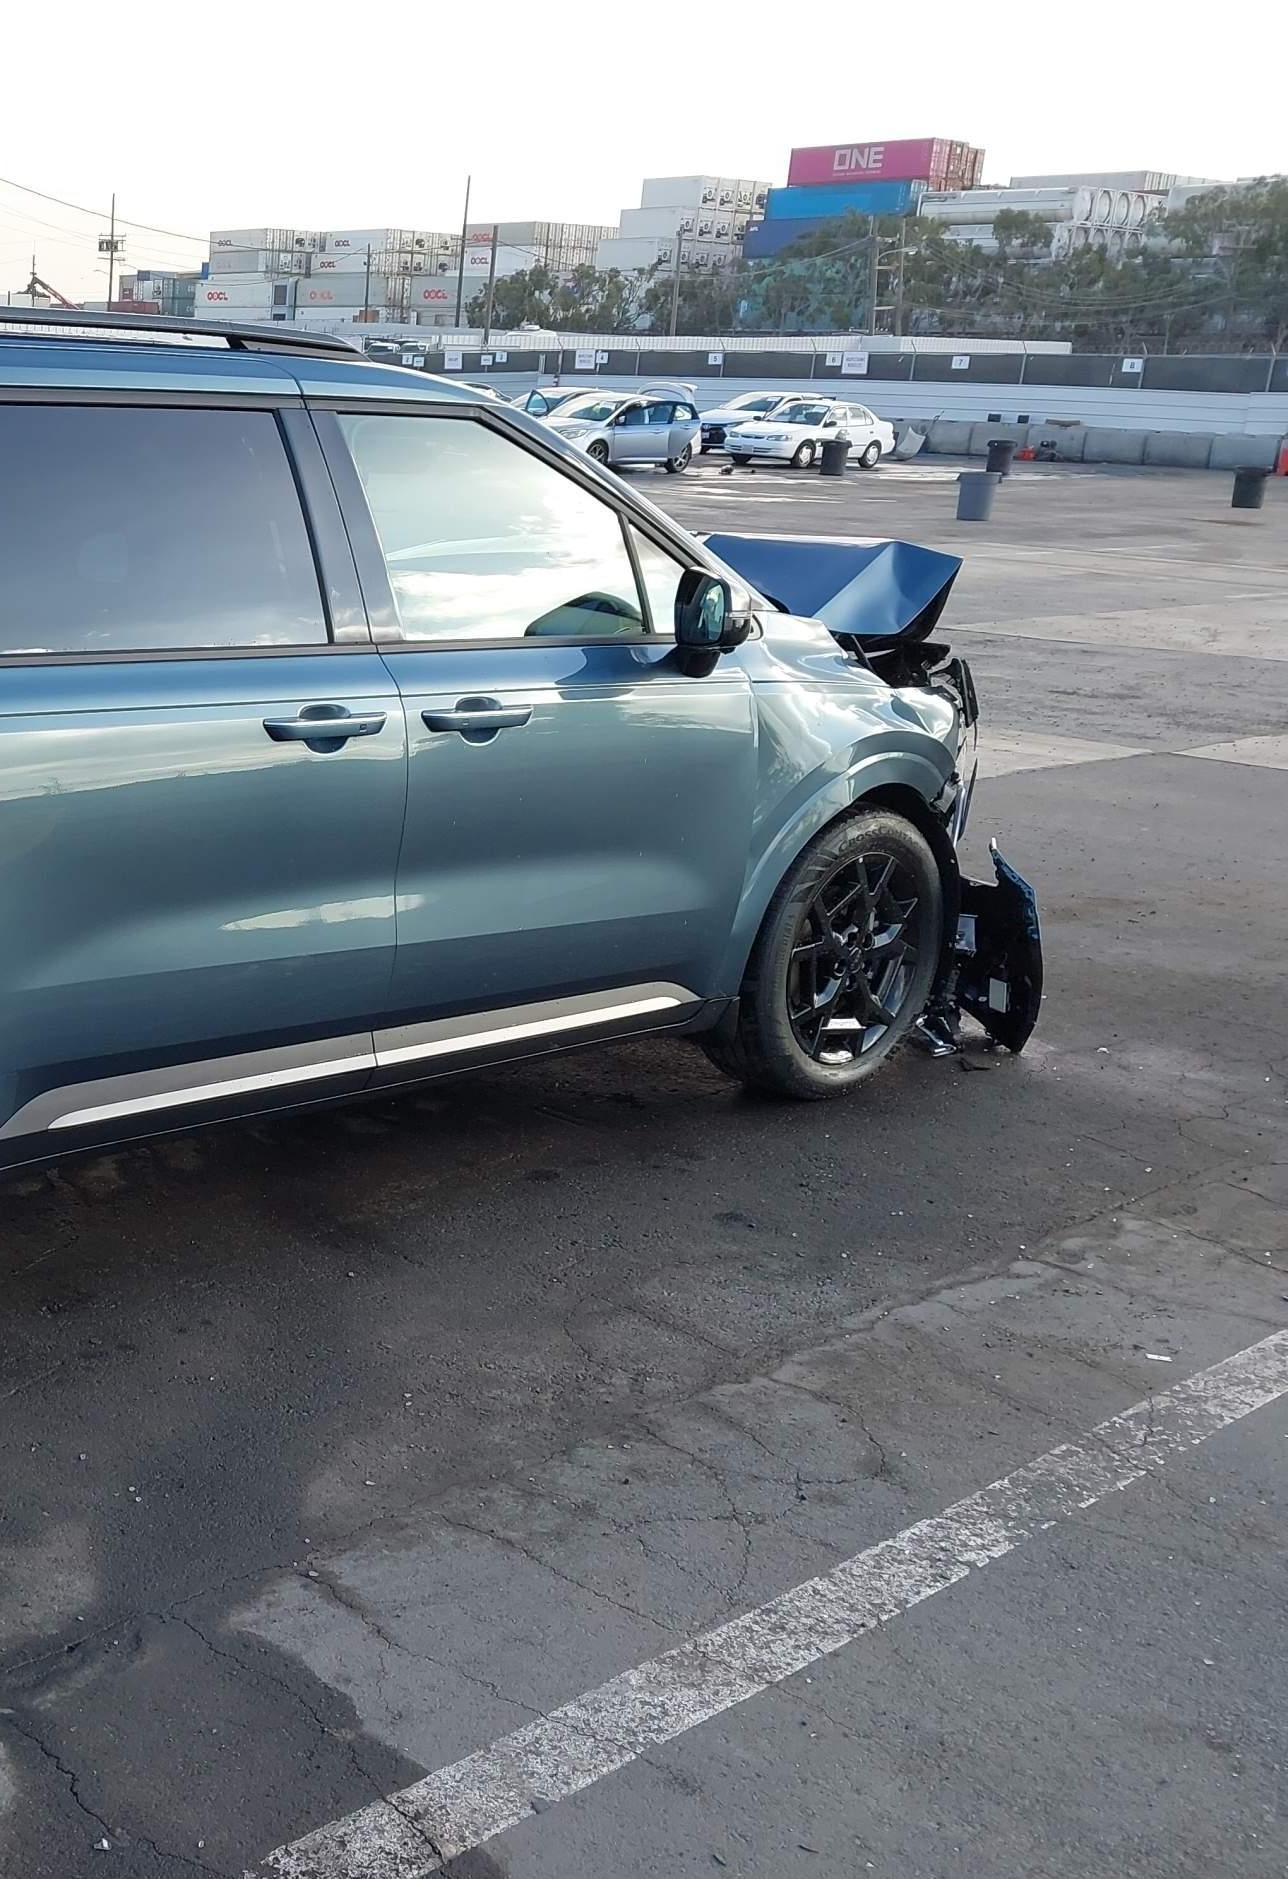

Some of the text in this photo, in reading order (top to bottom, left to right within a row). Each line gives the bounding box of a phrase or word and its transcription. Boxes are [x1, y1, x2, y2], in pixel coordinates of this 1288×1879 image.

[833, 147, 885, 171] ONE
[320, 261, 336, 269] OOCL
[470, 257, 489, 265] OOCL
[207, 292, 229, 301] OOCL
[424, 289, 448, 300] OOCL
